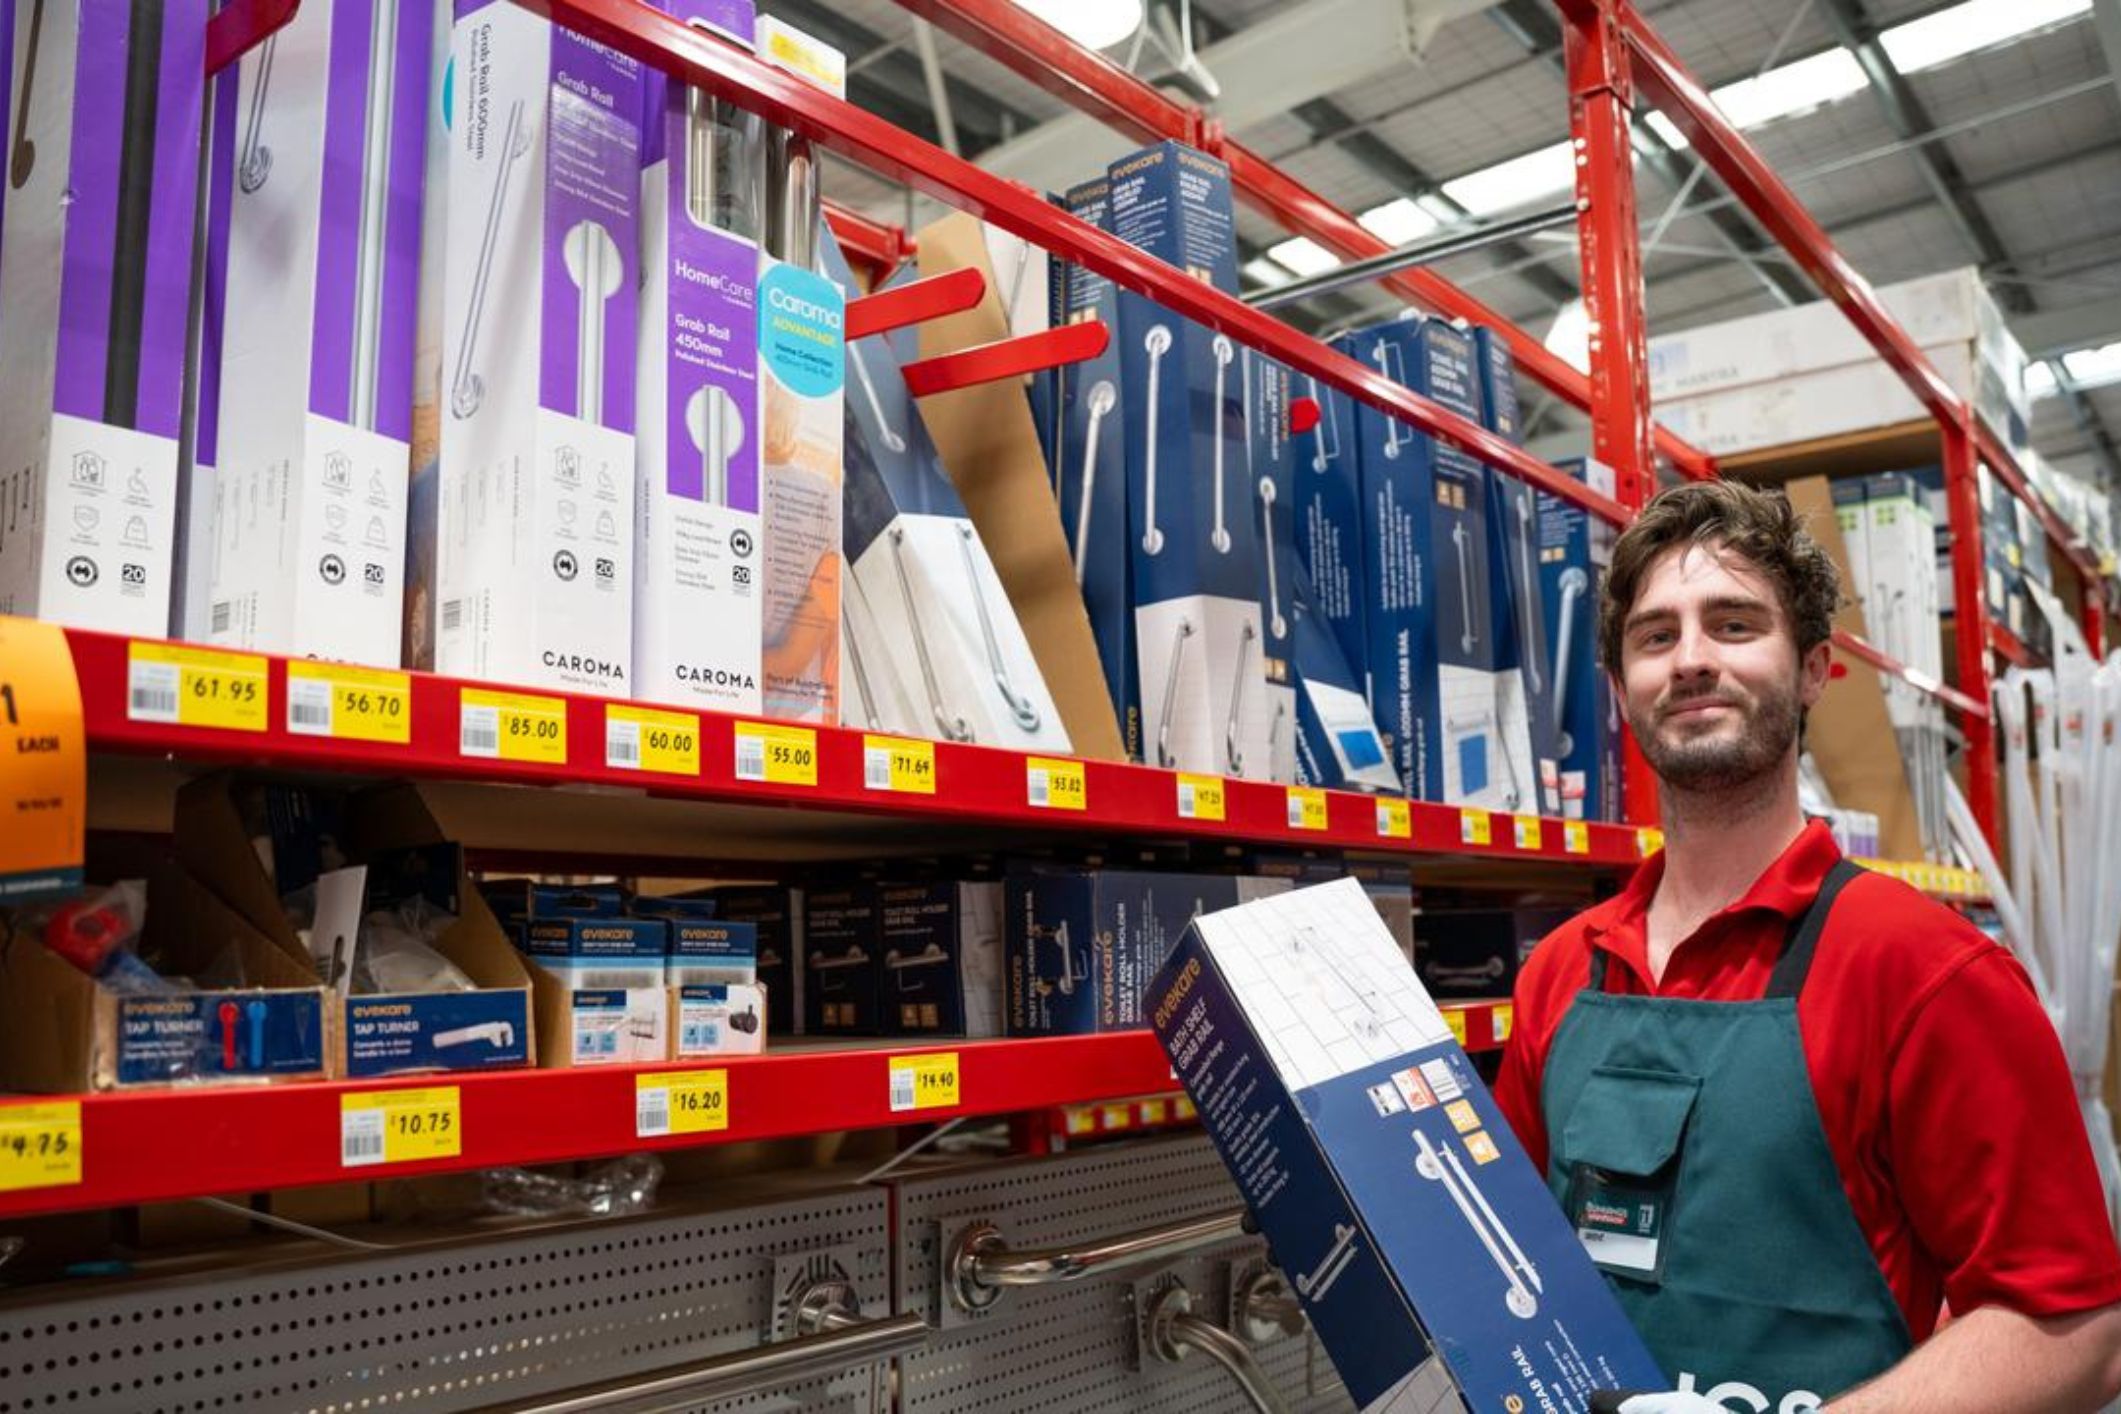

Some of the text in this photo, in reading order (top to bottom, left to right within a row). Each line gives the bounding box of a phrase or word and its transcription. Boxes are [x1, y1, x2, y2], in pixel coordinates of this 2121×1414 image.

[557, 69, 589, 97] Grab
[590, 86, 614, 108] Rail
[675, 259, 753, 301] HomeCare
[675, 313, 731, 342] Grab Rail
[769, 287, 842, 330] Caroma
[675, 333, 724, 358] 450mm
[543, 651, 624, 679] CAROMA
[676, 664, 756, 690] CAROMA
[17, 736, 60, 754] EACH
[1101, 930, 1114, 1026] evekare
[1117, 902, 1127, 1023] TOILET ROLL HOLDER
[1125, 962, 1134, 1023] GRAB RAIL
[1155, 957, 1200, 1030] evekare
[126, 1019, 204, 1035] TAP TURNER
[355, 1020, 420, 1036] TAP TURNER
[1169, 997, 1208, 1054] BATH SHELF
[1178, 1020, 1215, 1070] GRAB RAIL
[1511, 1344, 1536, 1378] RAIL
